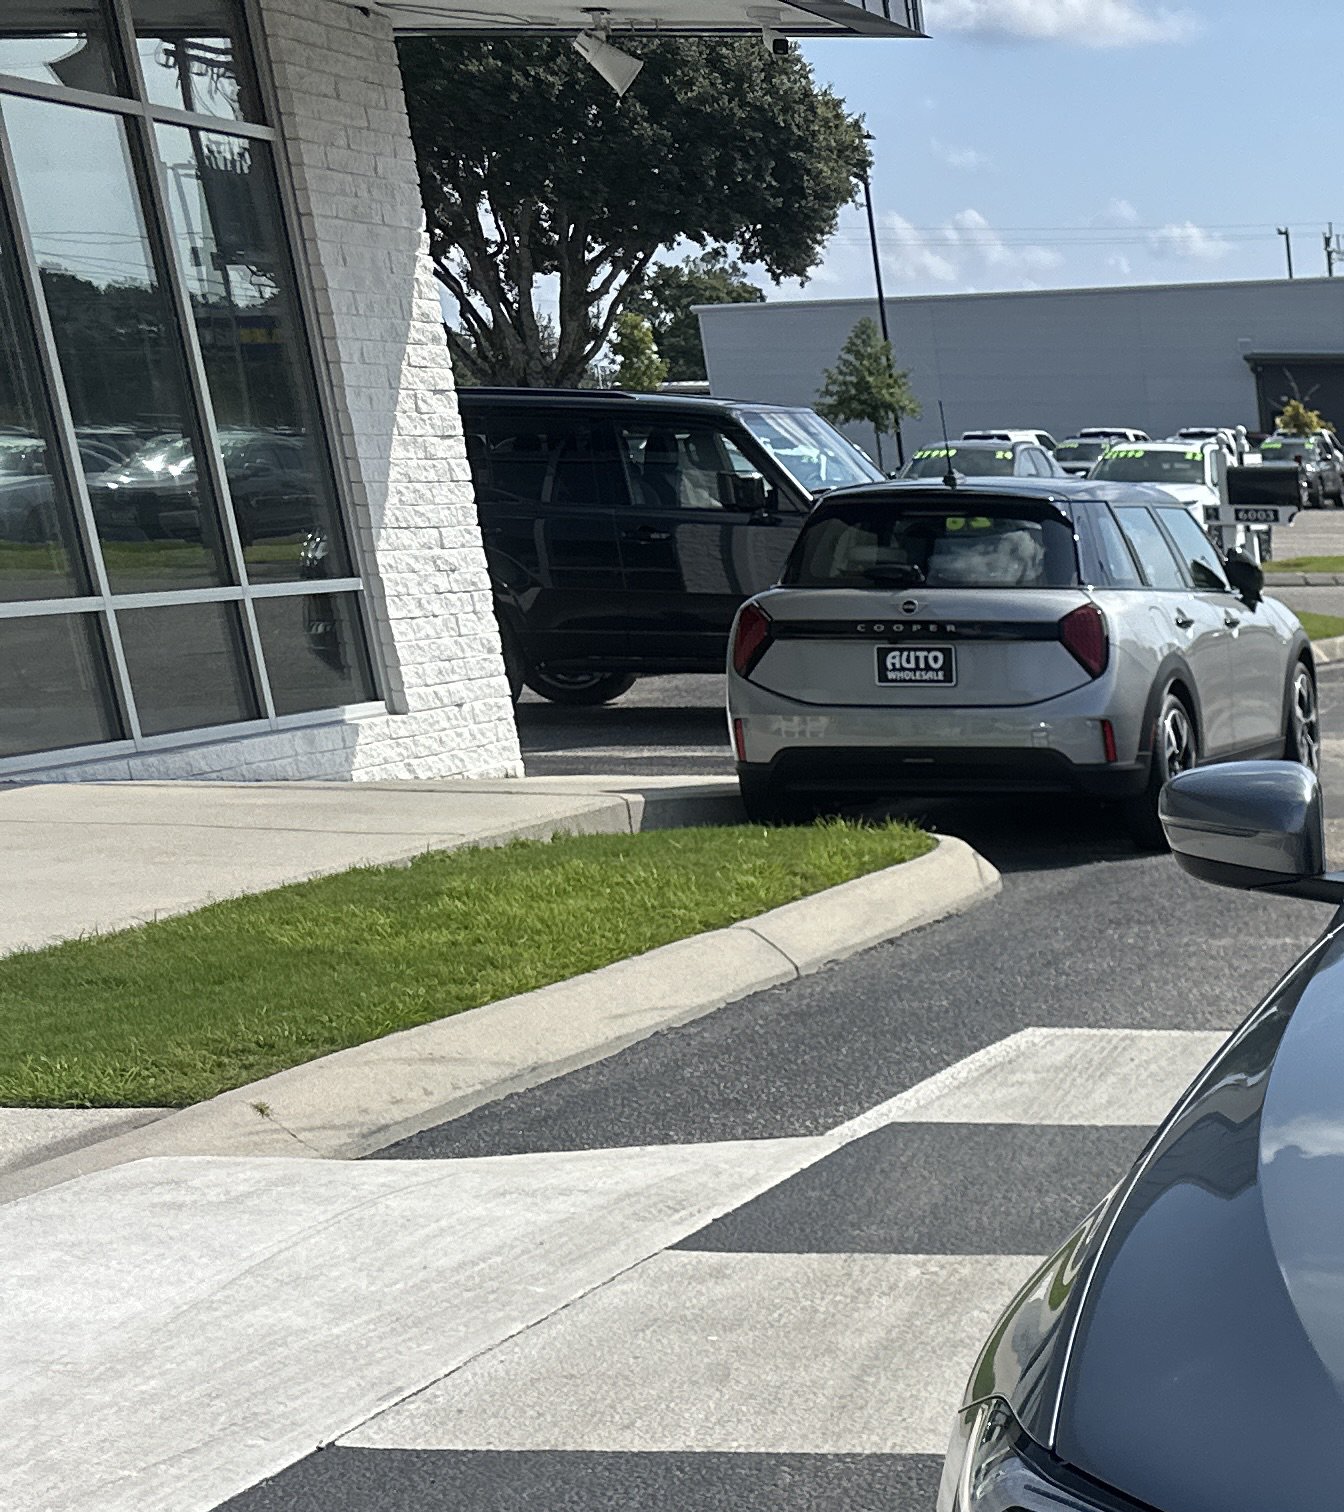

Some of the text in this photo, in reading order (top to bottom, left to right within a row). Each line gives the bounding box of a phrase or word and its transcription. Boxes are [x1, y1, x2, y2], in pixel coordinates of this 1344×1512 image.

[856, 623, 956, 633] COOPER
[885, 650, 944, 671] AUTO
[886, 670, 944, 681] WHOLESALE
